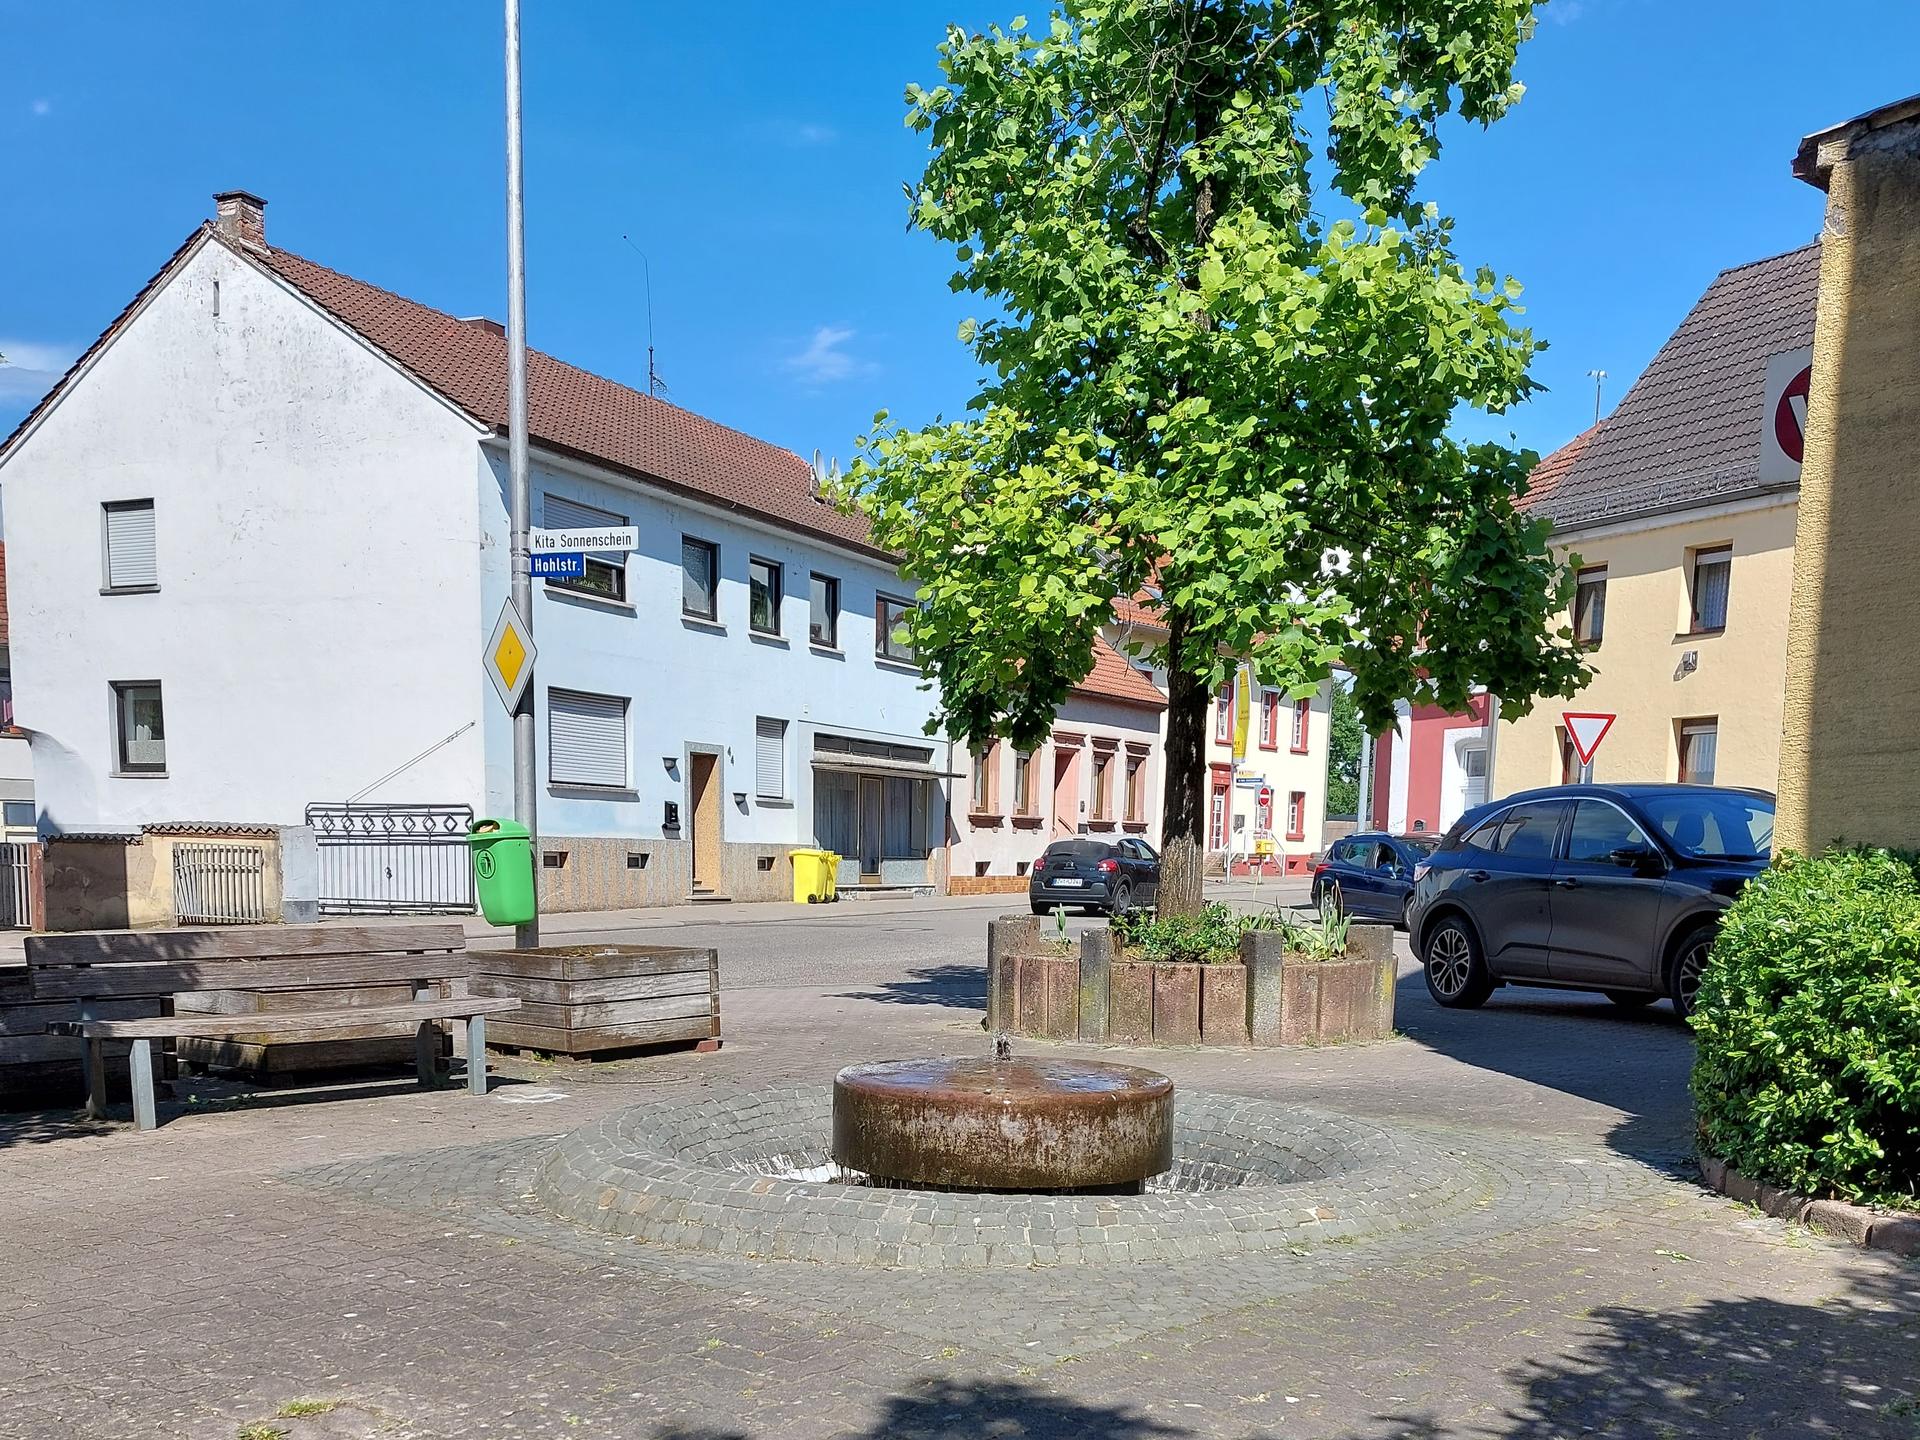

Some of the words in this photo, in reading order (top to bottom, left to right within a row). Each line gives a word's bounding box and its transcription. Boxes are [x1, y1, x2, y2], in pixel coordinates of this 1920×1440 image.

[535, 534, 555, 549] Kita
[560, 531, 632, 548] Sonnenschein
[535, 558, 581, 572] Hohlstr.
